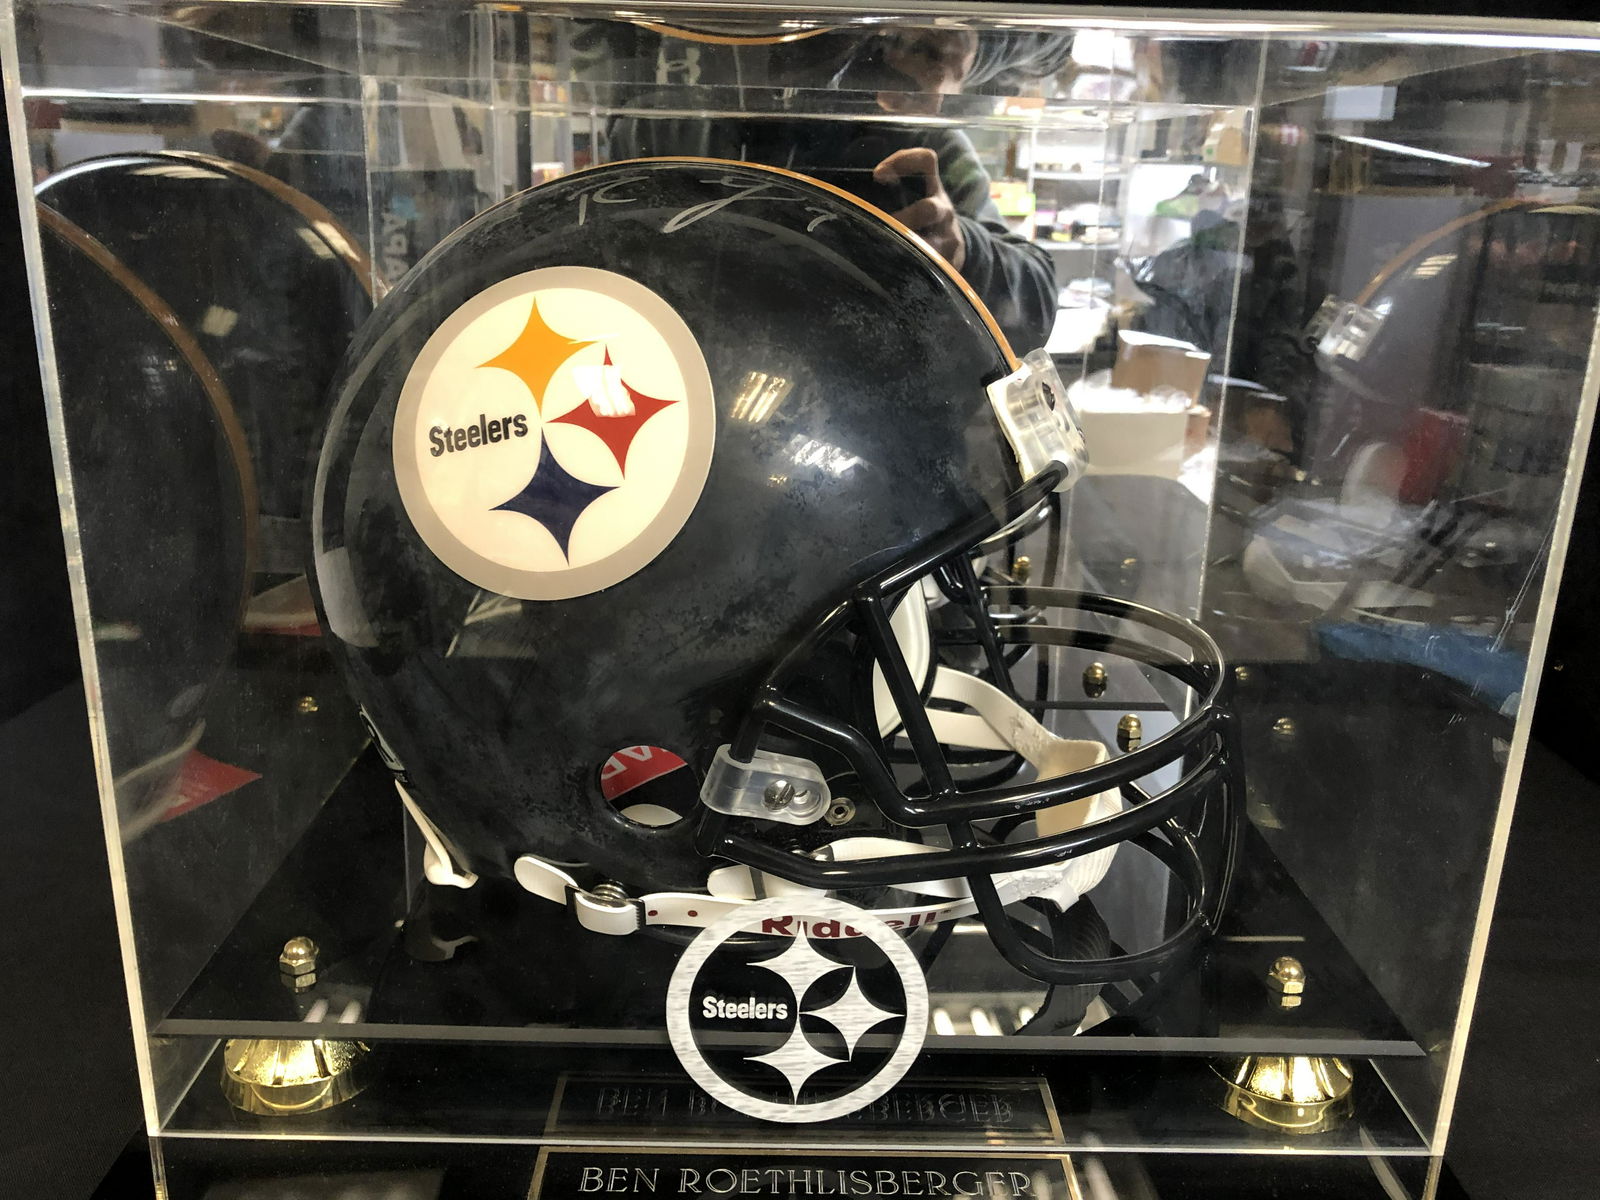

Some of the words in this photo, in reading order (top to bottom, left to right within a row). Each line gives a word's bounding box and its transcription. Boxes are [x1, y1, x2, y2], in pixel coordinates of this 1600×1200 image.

[429, 413, 528, 457] Steelers
[703, 996, 788, 1020] Steelers
[578, 1167, 660, 1193] BEN
[678, 1168, 1036, 1197] ROETHLISBERGER
